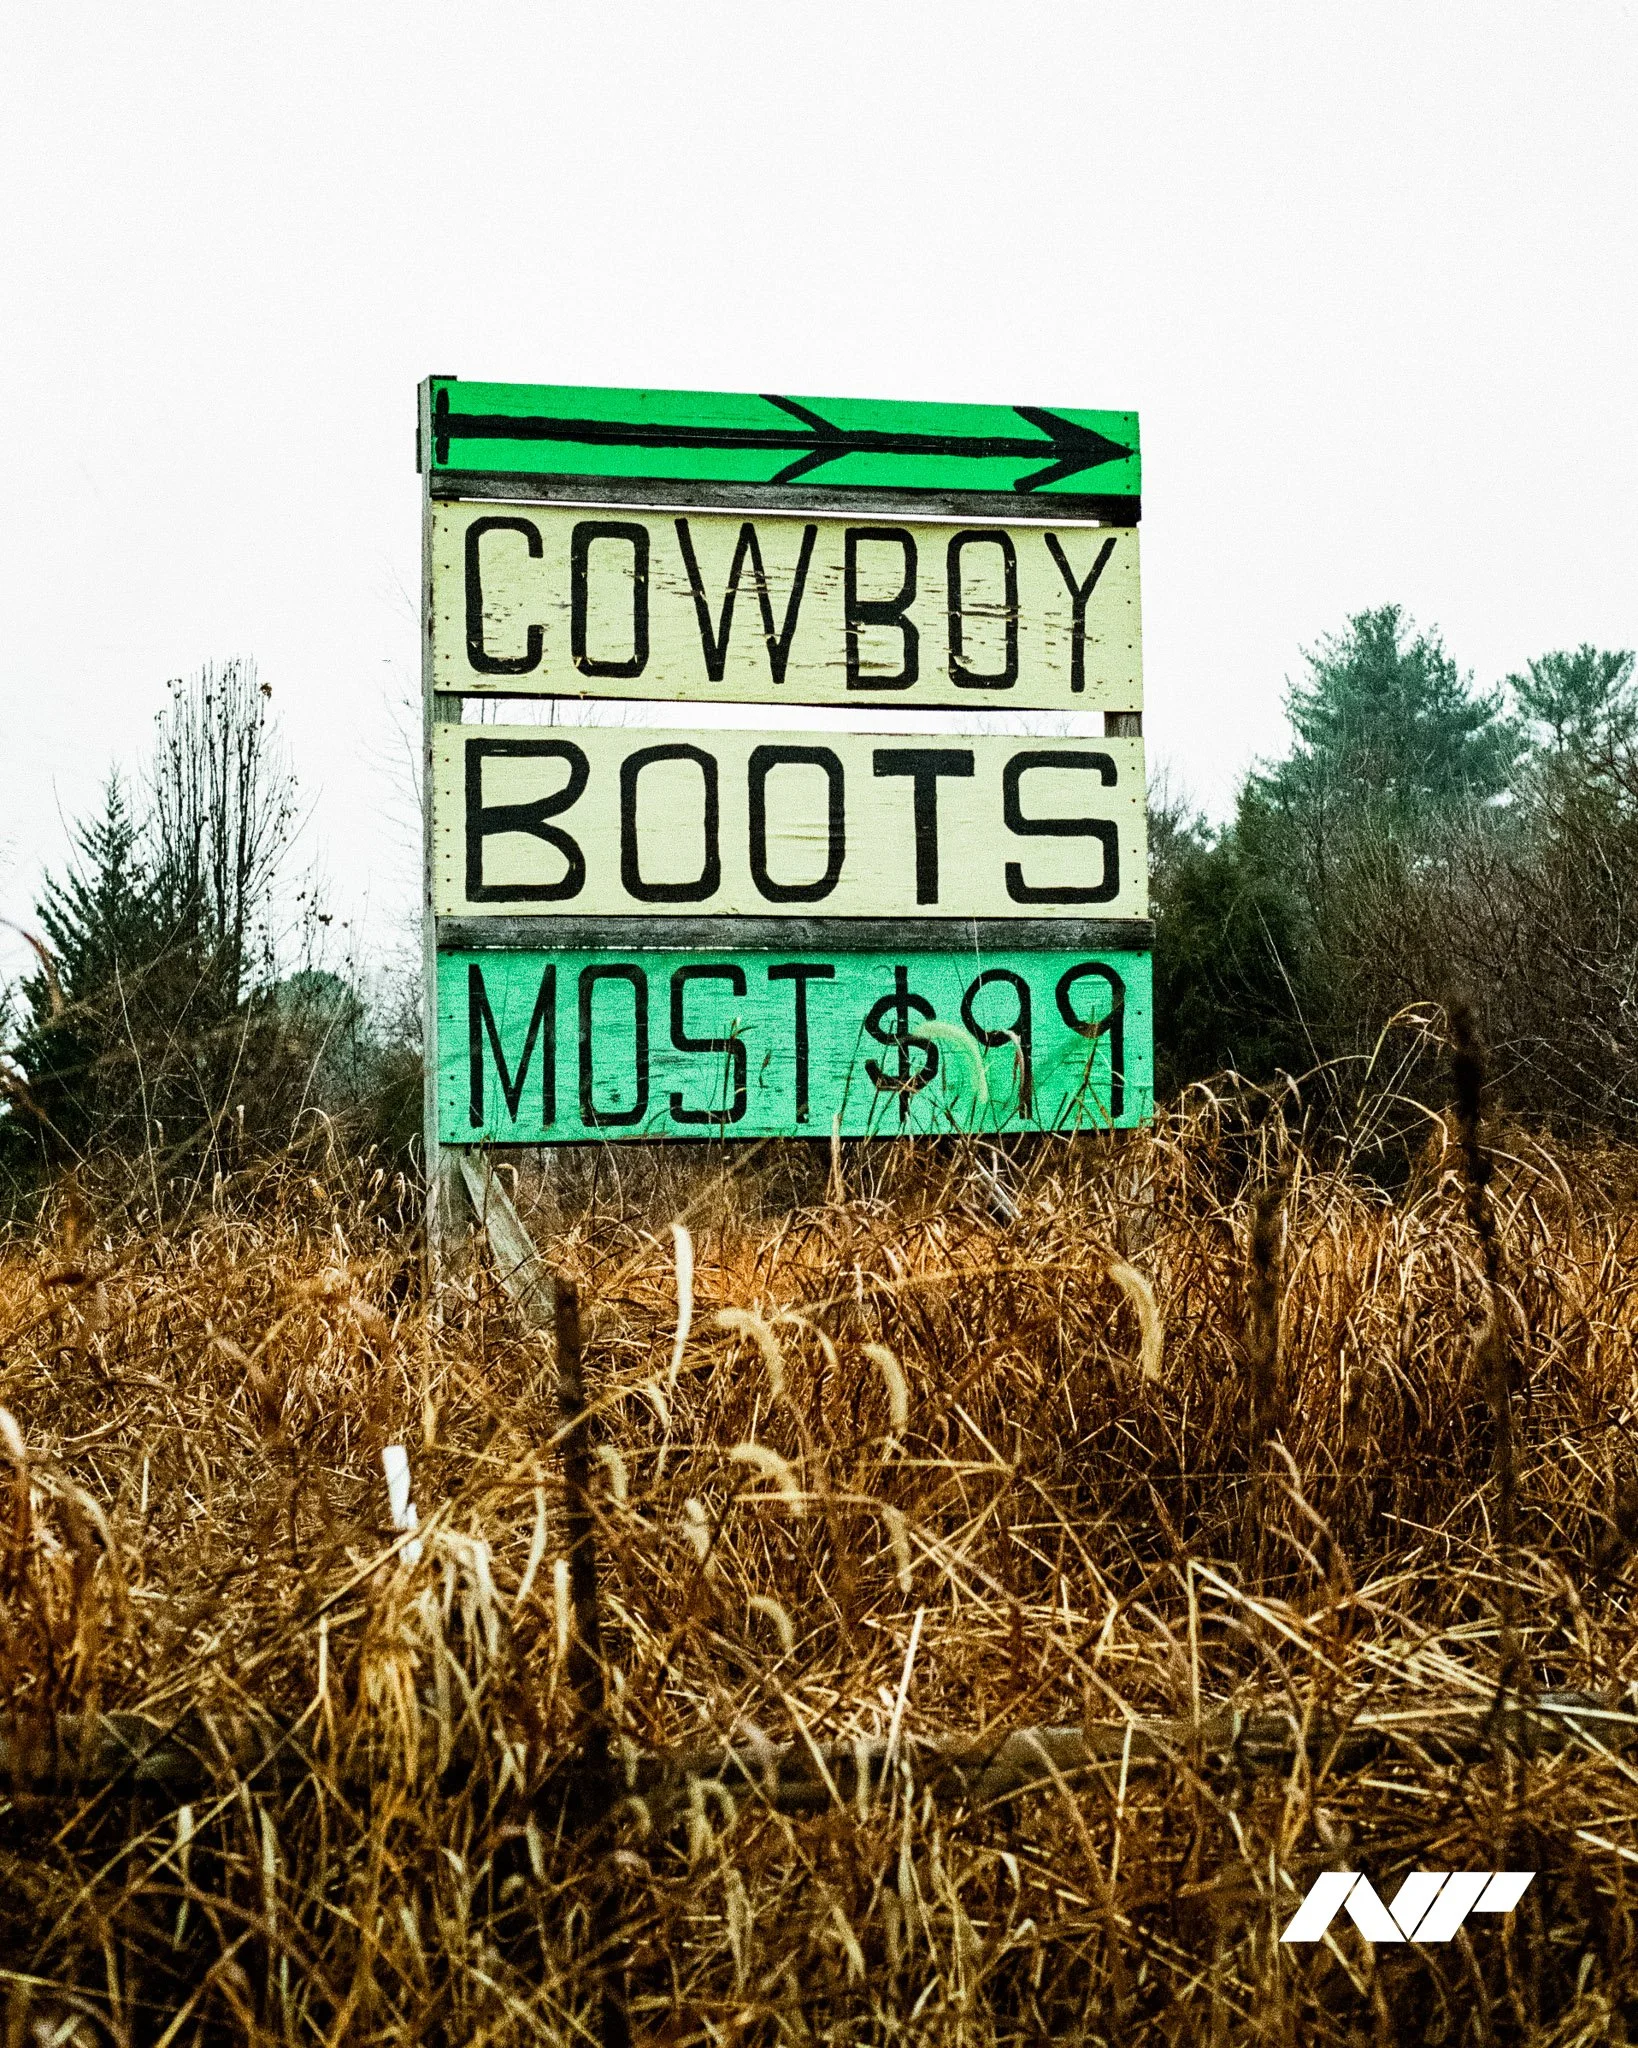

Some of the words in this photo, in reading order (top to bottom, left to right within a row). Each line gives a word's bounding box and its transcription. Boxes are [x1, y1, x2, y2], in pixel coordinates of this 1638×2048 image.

[464, 516, 1117, 693] COWBOY
[465, 738, 1121, 905] BOOTS
[468, 963, 836, 1129] MOST
[864, 962, 1126, 1124] $99
